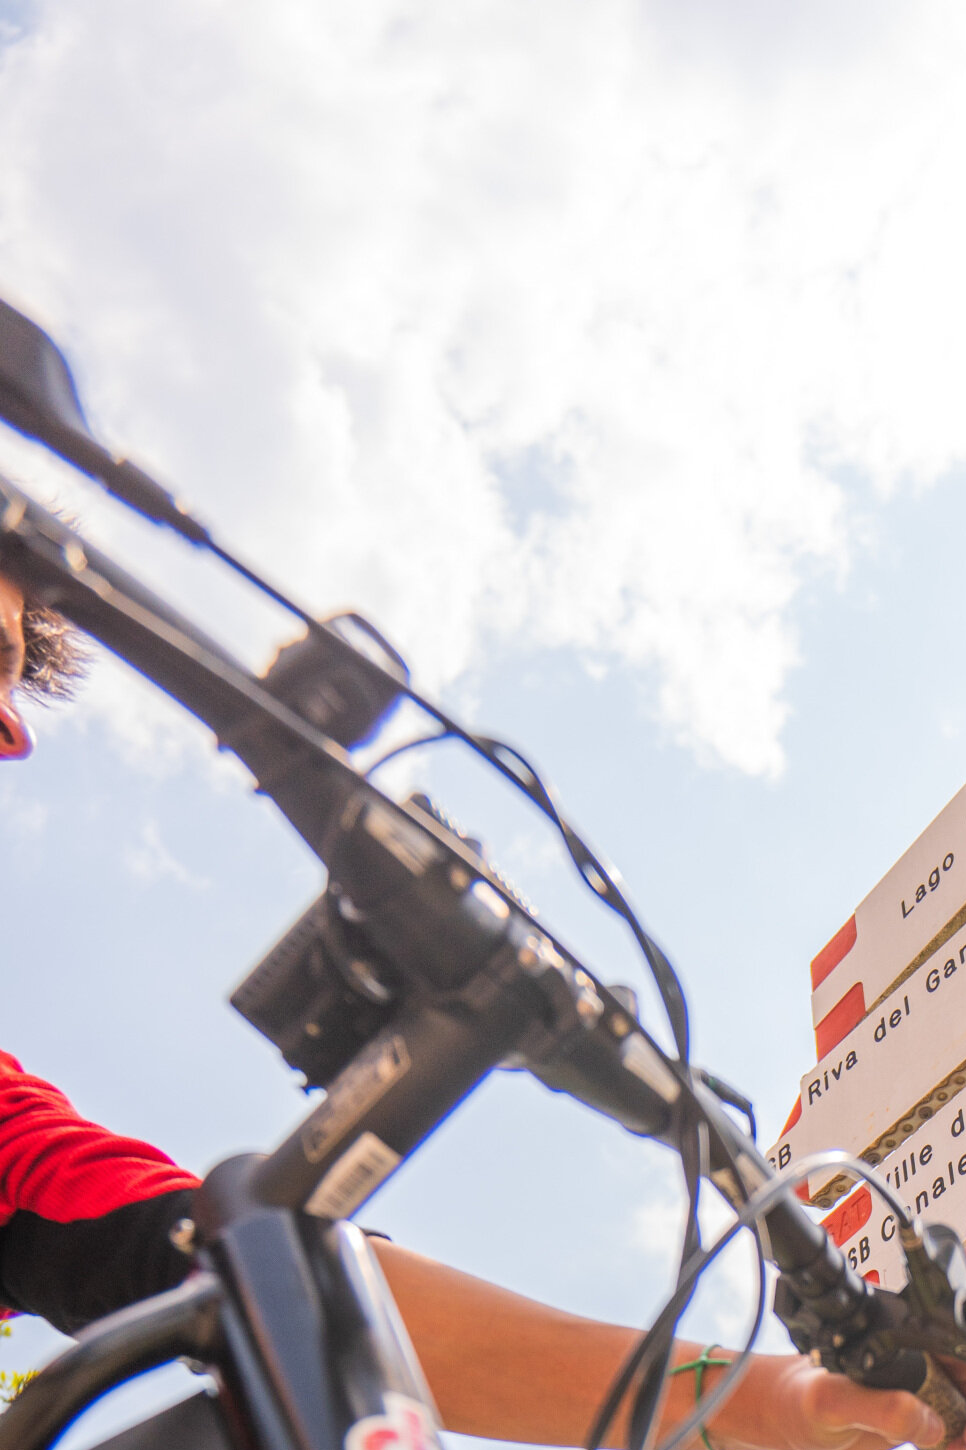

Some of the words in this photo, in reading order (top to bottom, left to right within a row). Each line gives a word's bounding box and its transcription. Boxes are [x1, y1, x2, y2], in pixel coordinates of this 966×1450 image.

[901, 852, 955, 919] Lago
[807, 1051, 858, 1105] Riva
[873, 996, 911, 1043] del
[886, 1143, 933, 1190] ille
